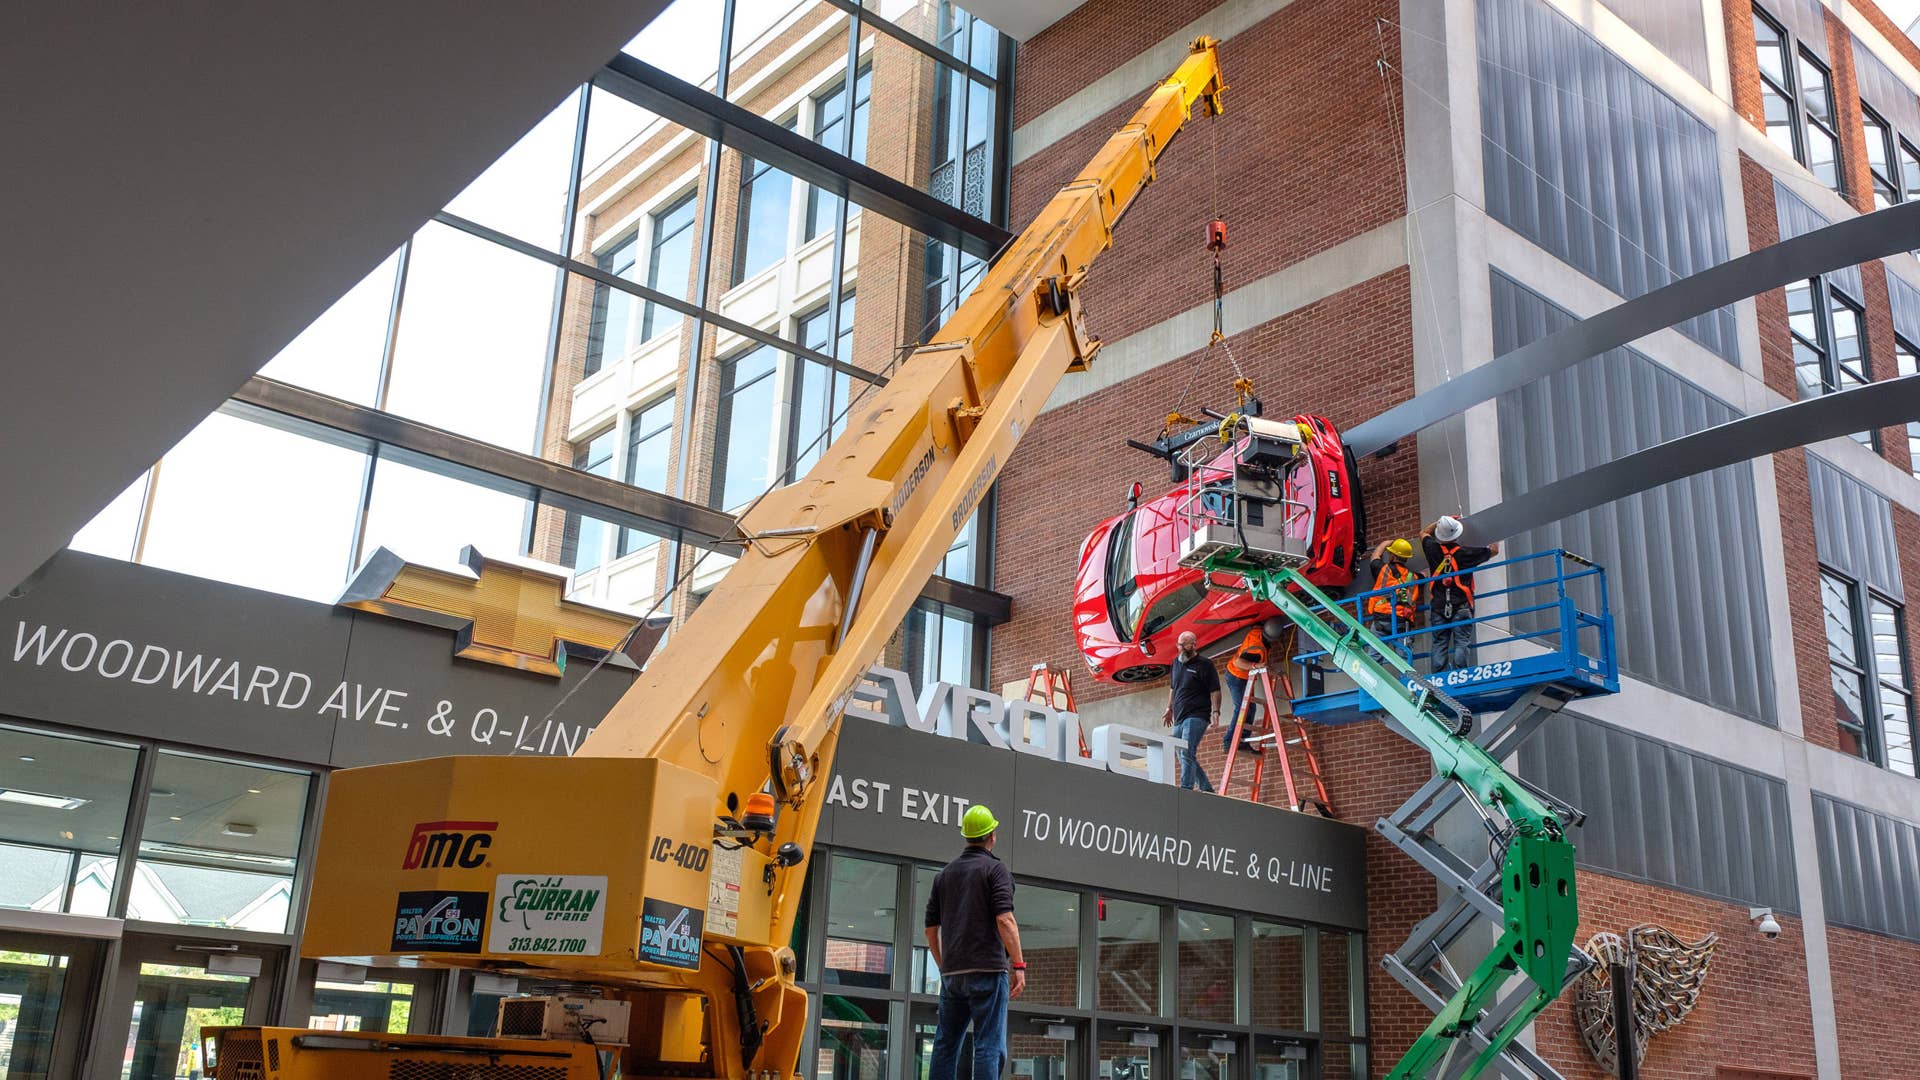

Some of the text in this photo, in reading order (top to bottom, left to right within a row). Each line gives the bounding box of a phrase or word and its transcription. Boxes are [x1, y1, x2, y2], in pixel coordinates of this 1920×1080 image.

[892, 446, 935, 516] RODERSON
[952, 453, 997, 531] BRODERSON
[13, 621, 312, 709] WOODWARD
[317, 681, 409, 729] AVE.
[427, 700, 456, 737] &
[1448, 662, 1512, 686] GS-2632
[844, 664, 1188, 784] EVROLET
[827, 775, 970, 827] AST EXIT
[649, 836, 709, 872] IC-400
[1022, 809, 1333, 892] TO WOODWARD AVE. & Q-LINE
[513, 888, 601, 912] CURRAN
[540, 877, 563, 888] JJ
[395, 906, 481, 940] PAYTON
[545, 911, 590, 922] crane
[644, 914, 667, 925] WALTER
[508, 937, 587, 953] 313.842.1700
[641, 916, 700, 956] PAYTON
